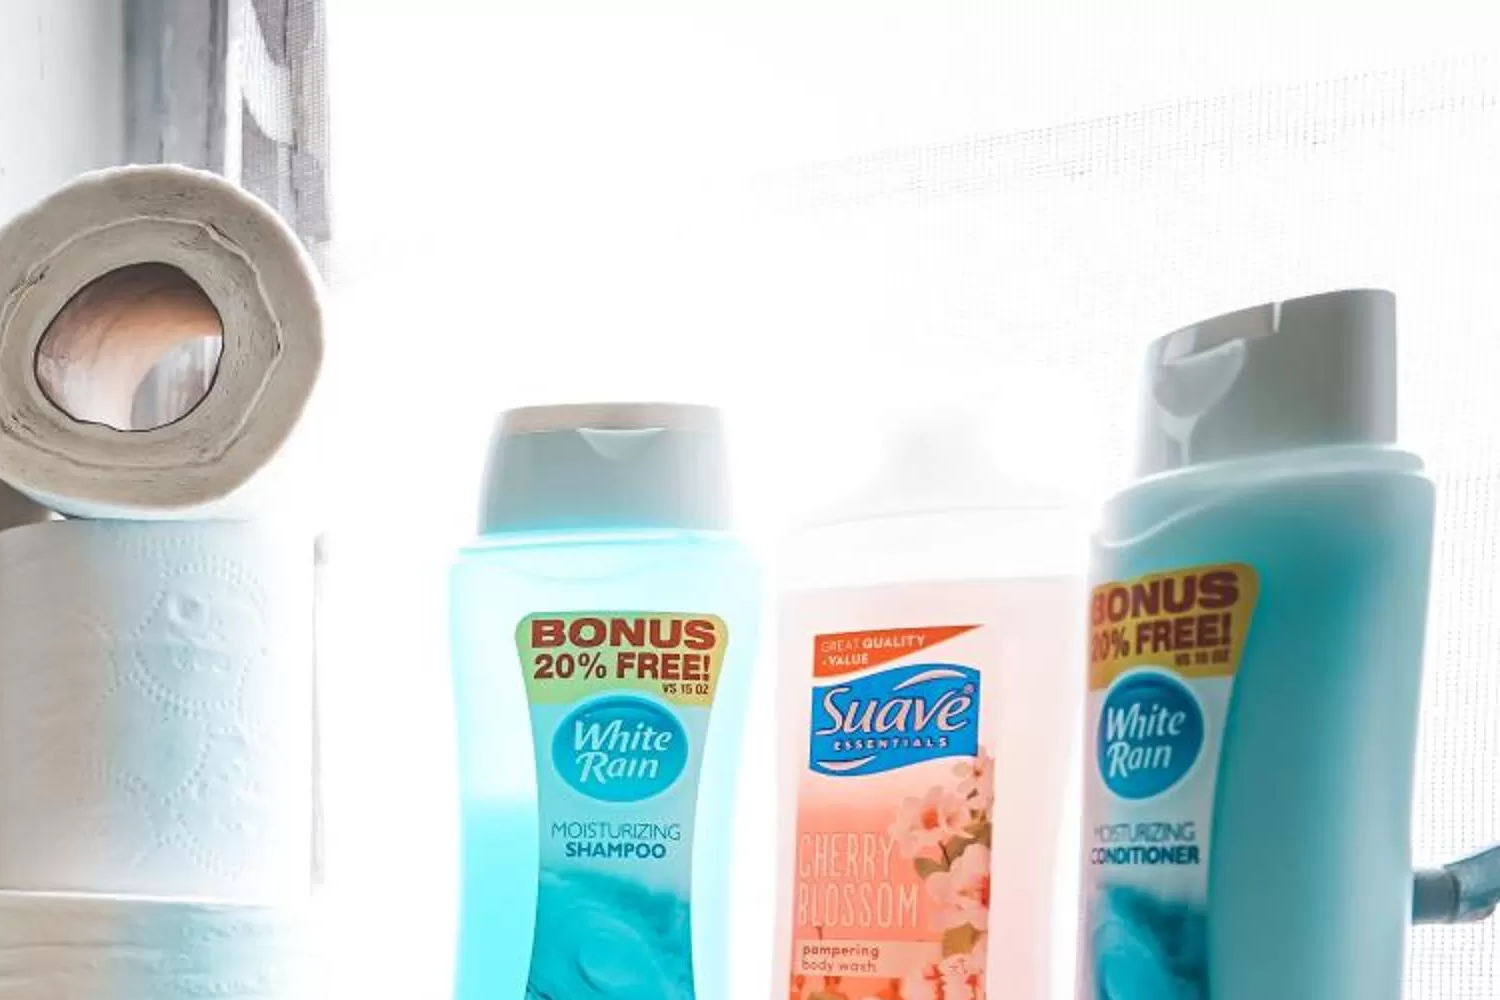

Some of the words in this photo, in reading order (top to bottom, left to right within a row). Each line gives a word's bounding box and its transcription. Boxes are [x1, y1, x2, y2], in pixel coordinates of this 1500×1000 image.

[1091, 571, 1239, 626] BONUS
[531, 617, 717, 651] BONUS
[820, 638, 860, 652] GREAT
[862, 635, 925, 649] QUALITY
[1135, 612, 1232, 655] FREE!
[533, 652, 607, 680] 20%
[616, 652, 710, 682] FREE!
[815, 686, 972, 736] Suave
[1106, 703, 1186, 741] White
[573, 719, 673, 752] White
[833, 737, 948, 752] ESSENTIALS
[575, 751, 660, 784] Rain
[1107, 741, 1173, 779] Rain
[551, 821, 681, 842] MOISTURIZING
[565, 841, 667, 860] SHAMPOO
[800, 832, 896, 880] CHERRY
[1091, 845, 1201, 865] CONDITIONER
[800, 883, 920, 929] BLOSSOM
[802, 960, 832, 973] body
[839, 960, 877, 973] wash
[803, 944, 879, 960] pampering
